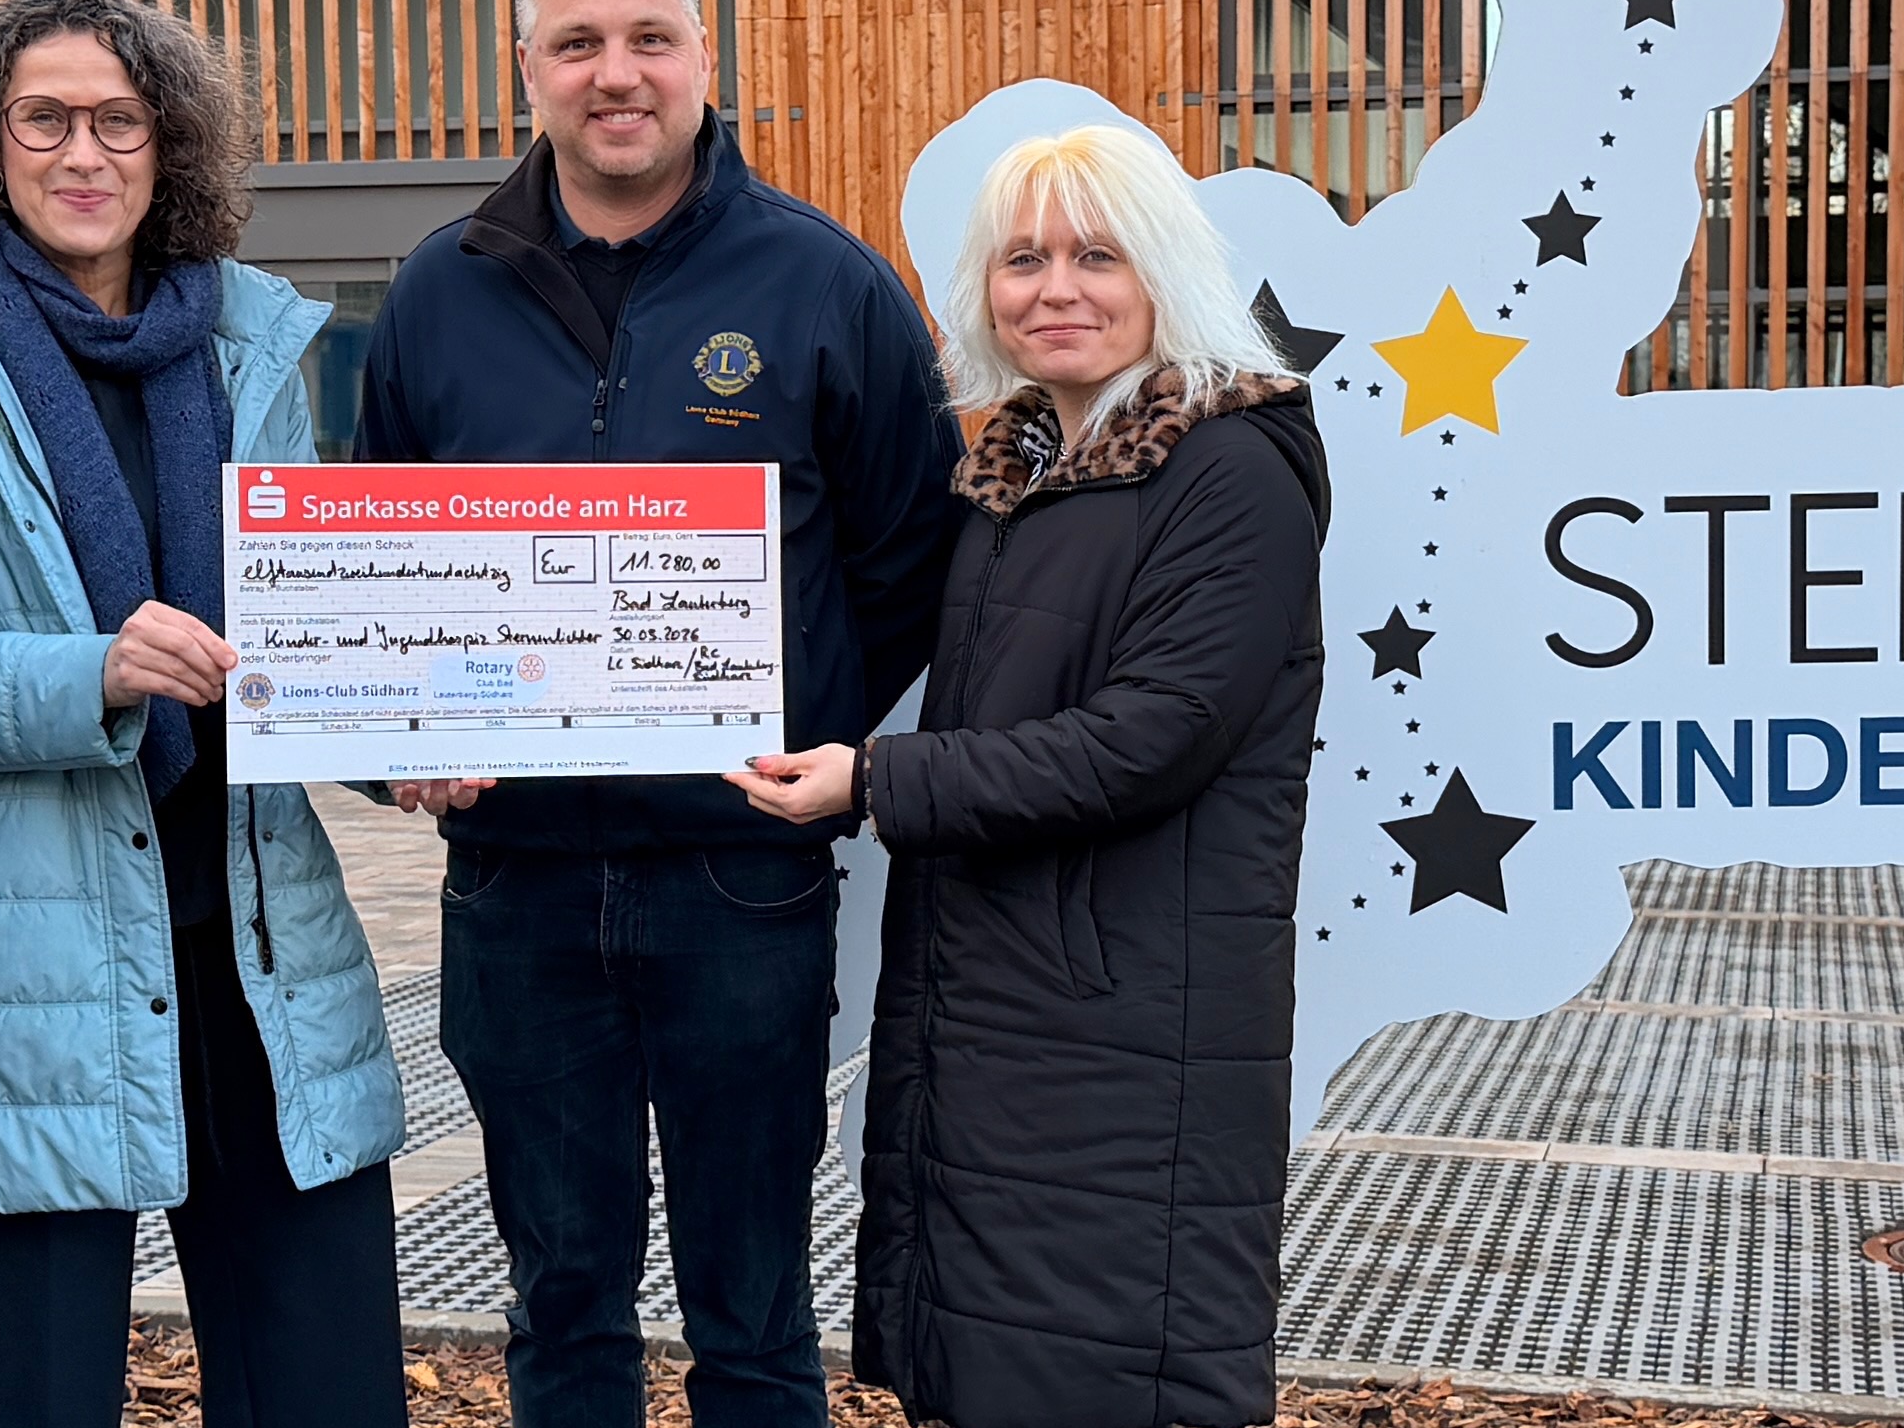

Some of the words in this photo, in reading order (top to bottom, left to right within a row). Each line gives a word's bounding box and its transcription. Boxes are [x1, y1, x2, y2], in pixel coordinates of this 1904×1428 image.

[302, 494, 441, 525] Sparkasse
[448, 494, 571, 520] Osterode
[579, 499, 619, 518] am
[628, 493, 688, 518] Harz
[239, 540, 276, 551] Zahlen
[280, 540, 297, 550] Sie
[300, 541, 334, 553] gegen
[337, 540, 371, 551] diesen
[375, 539, 414, 550] Scheck
[541, 549, 575, 575] Eur
[613, 590, 651, 612] Bad
[240, 641, 254, 650] an
[241, 653, 265, 663] oder
[269, 651, 332, 665] Überbringer
[466, 661, 513, 677] Rotary
[282, 684, 358, 698] Lions-Club
[361, 683, 420, 697] Südharz
[476, 679, 495, 687] Club
[497, 679, 513, 687] Bad
